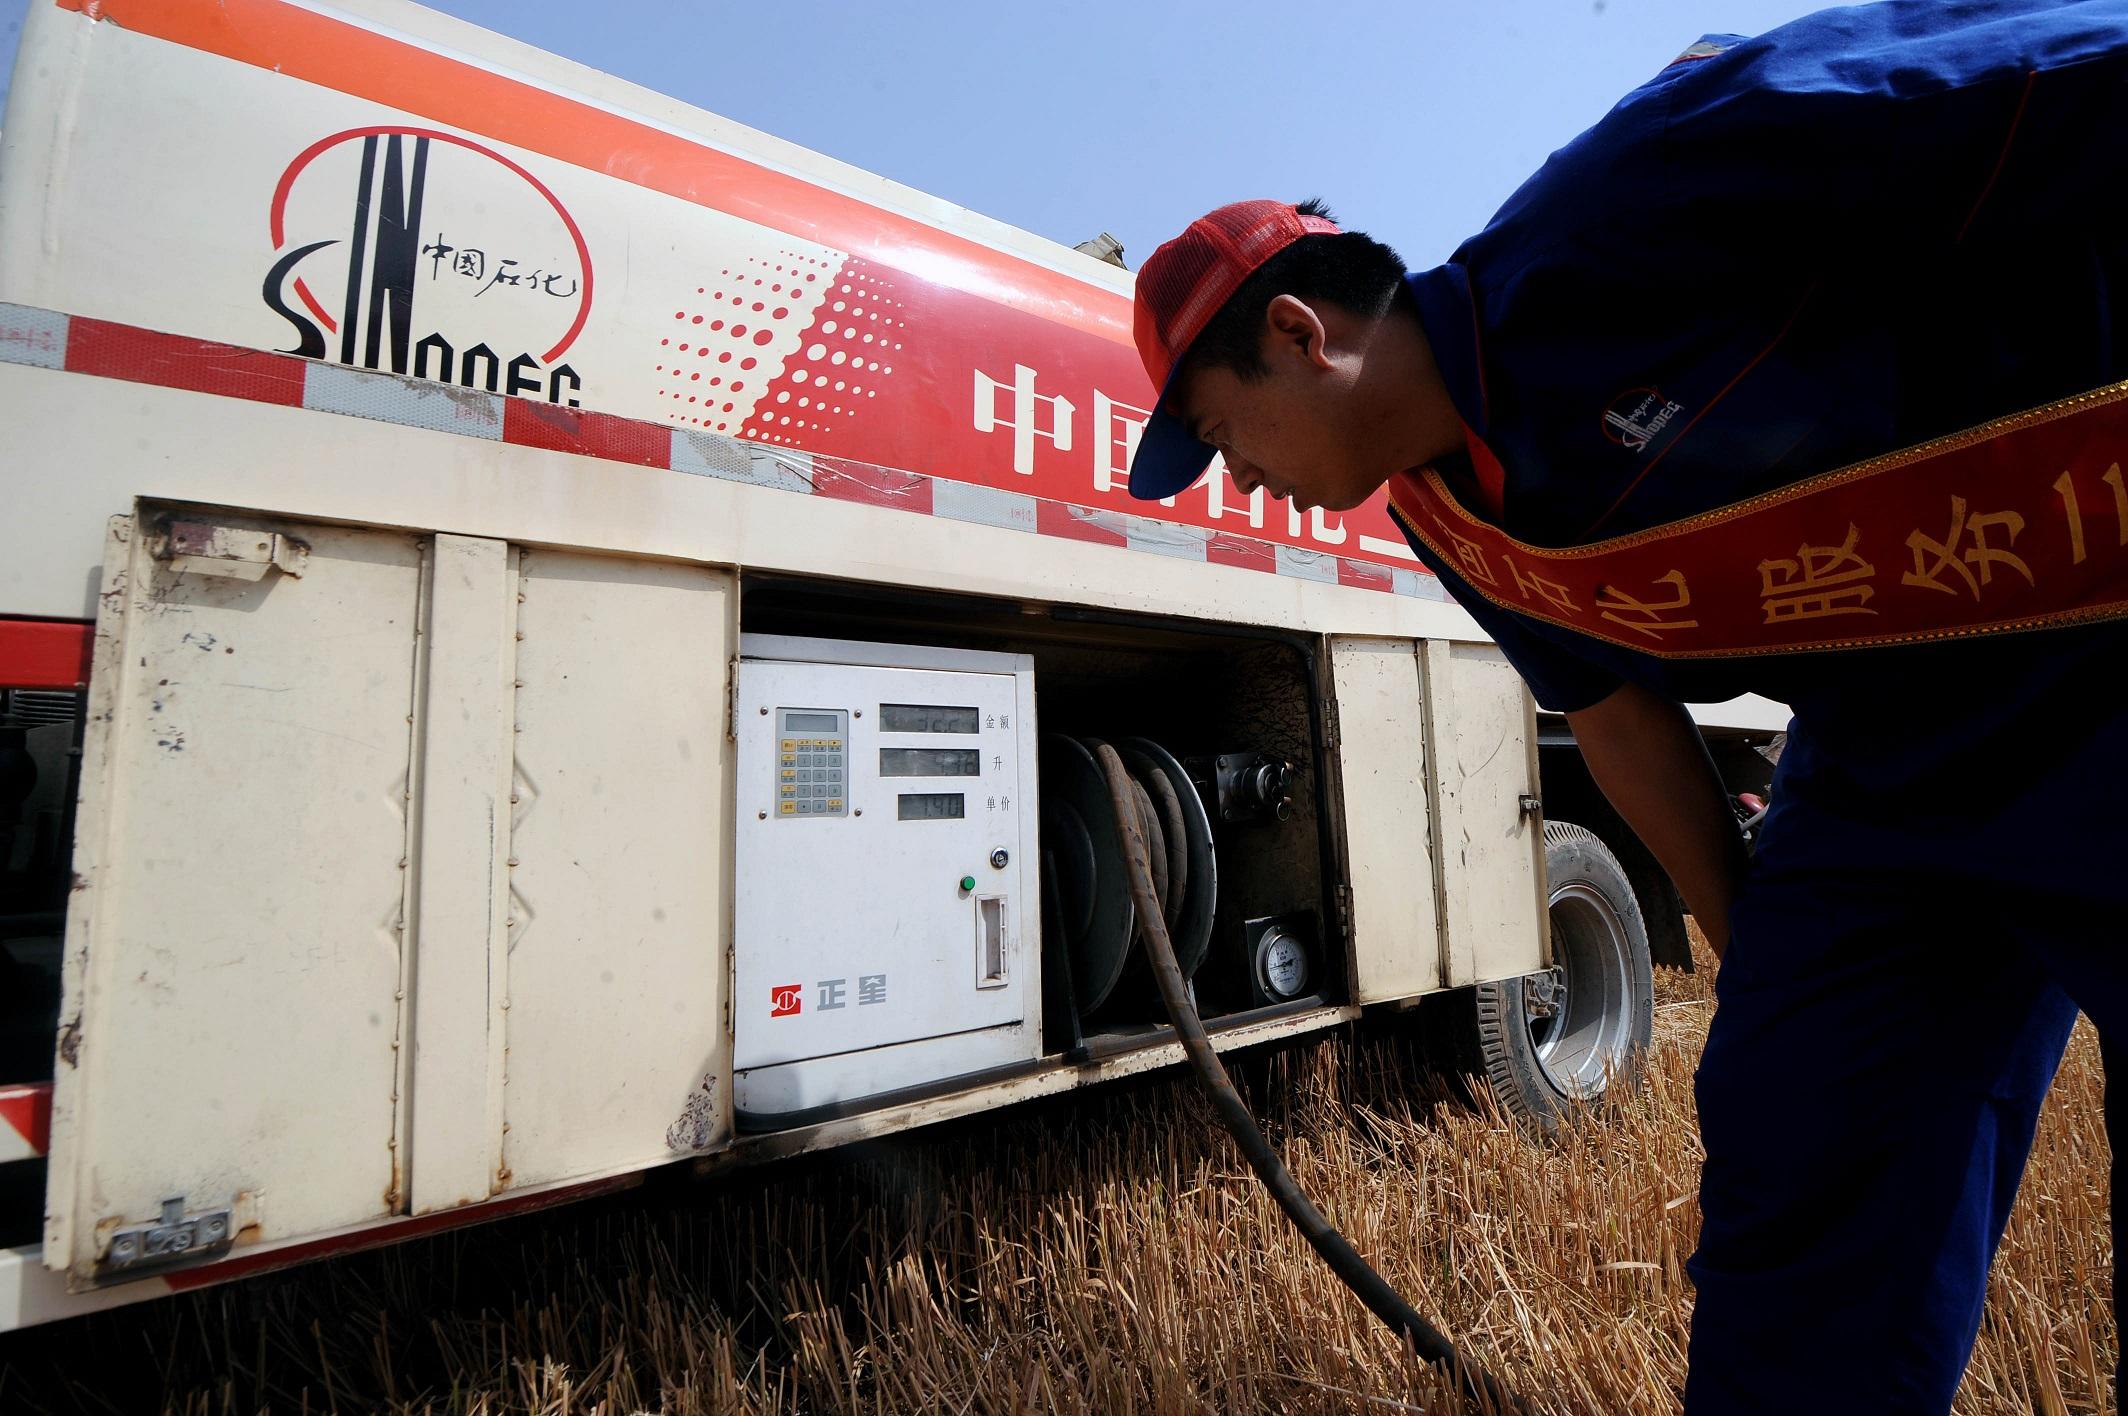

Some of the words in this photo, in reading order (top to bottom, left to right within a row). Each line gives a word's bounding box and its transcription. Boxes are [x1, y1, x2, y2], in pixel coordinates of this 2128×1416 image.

[985, 713, 1010, 730] 金额
[991, 755, 1004, 771] 升
[986, 795, 1011, 812] 单价
[817, 974, 887, 1012] 正星
